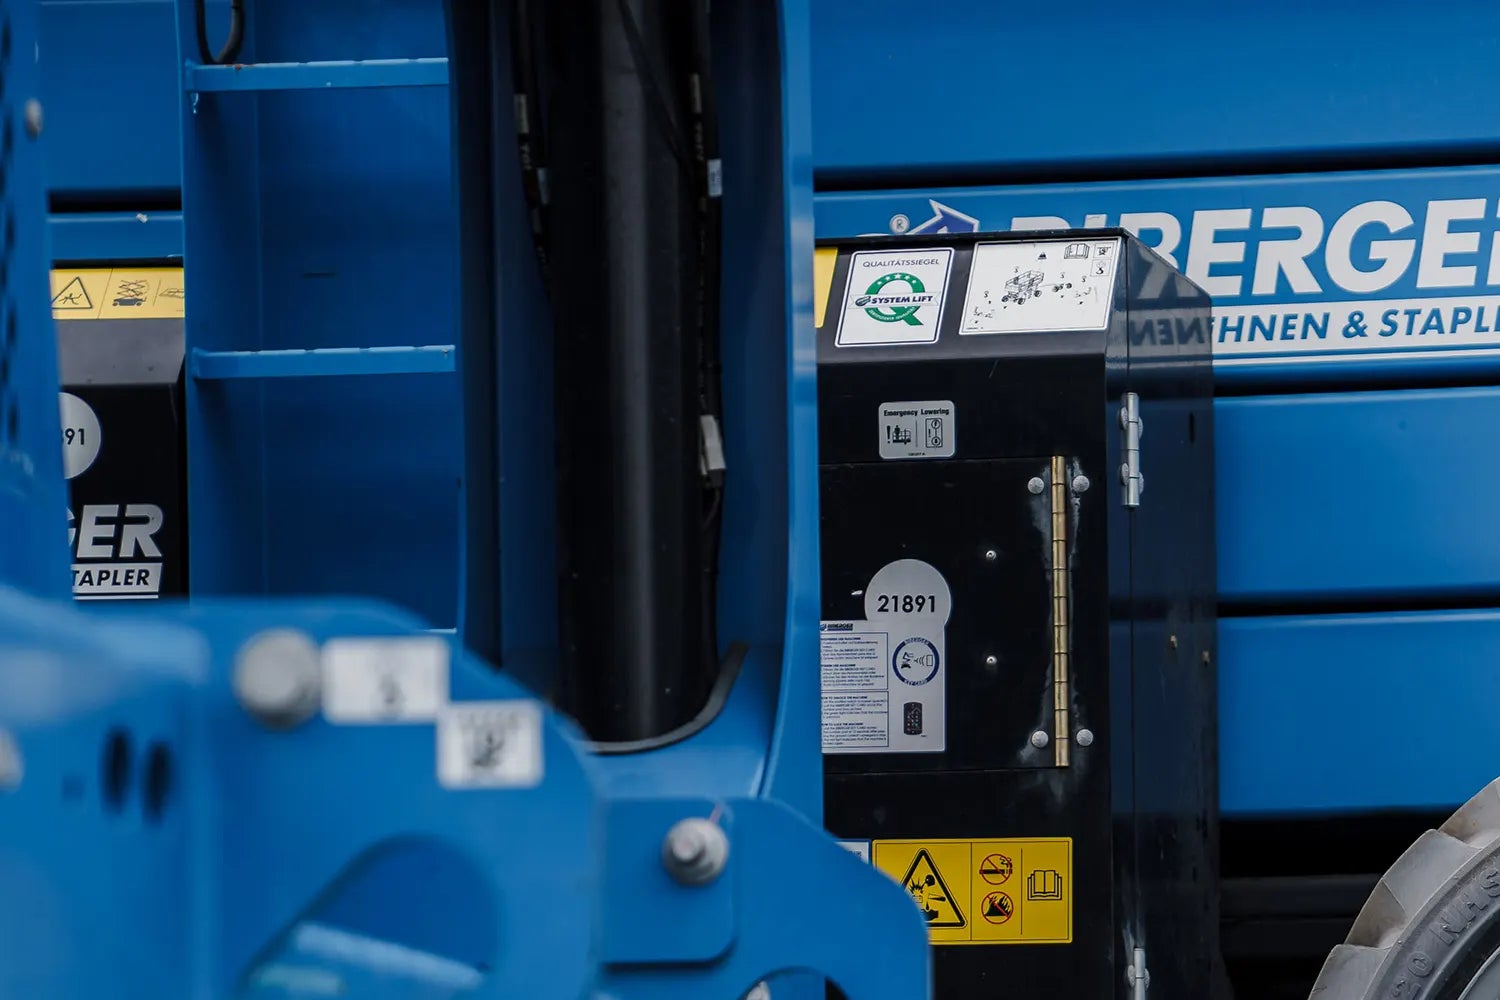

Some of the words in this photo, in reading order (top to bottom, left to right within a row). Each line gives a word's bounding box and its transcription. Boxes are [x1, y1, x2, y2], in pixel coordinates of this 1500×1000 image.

[871, 296, 910, 304] SYSTEM
[1342, 309, 1370, 338] &
[921, 408, 949, 416] Lowering
[877, 595, 936, 613] 21891
